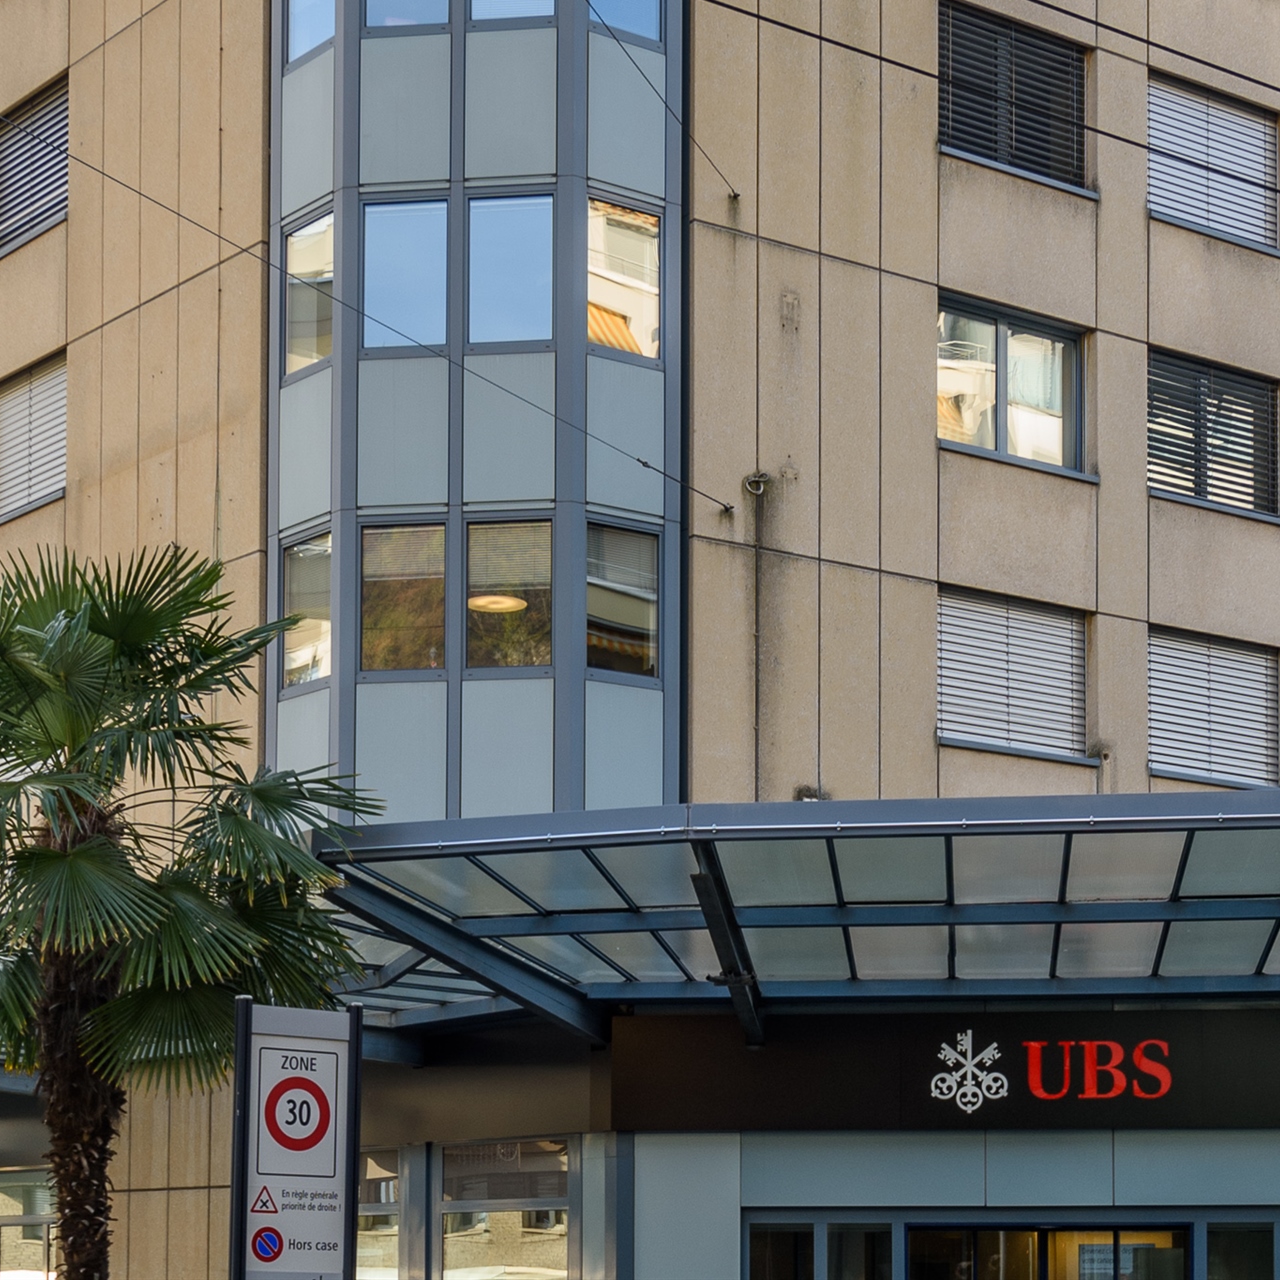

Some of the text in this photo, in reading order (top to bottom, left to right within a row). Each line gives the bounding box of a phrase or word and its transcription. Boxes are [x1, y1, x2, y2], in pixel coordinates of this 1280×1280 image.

[281, 1055, 317, 1072] ZONE
[1022, 1039, 1173, 1100] UBS
[285, 1099, 311, 1126] 30
[281, 1189, 338, 1201] En règle générale
[281, 1201, 306, 1212] priorité
[308, 1202, 315, 1211] de
[317, 1203, 337, 1212] droite
[288, 1238, 338, 1251] Hors case
